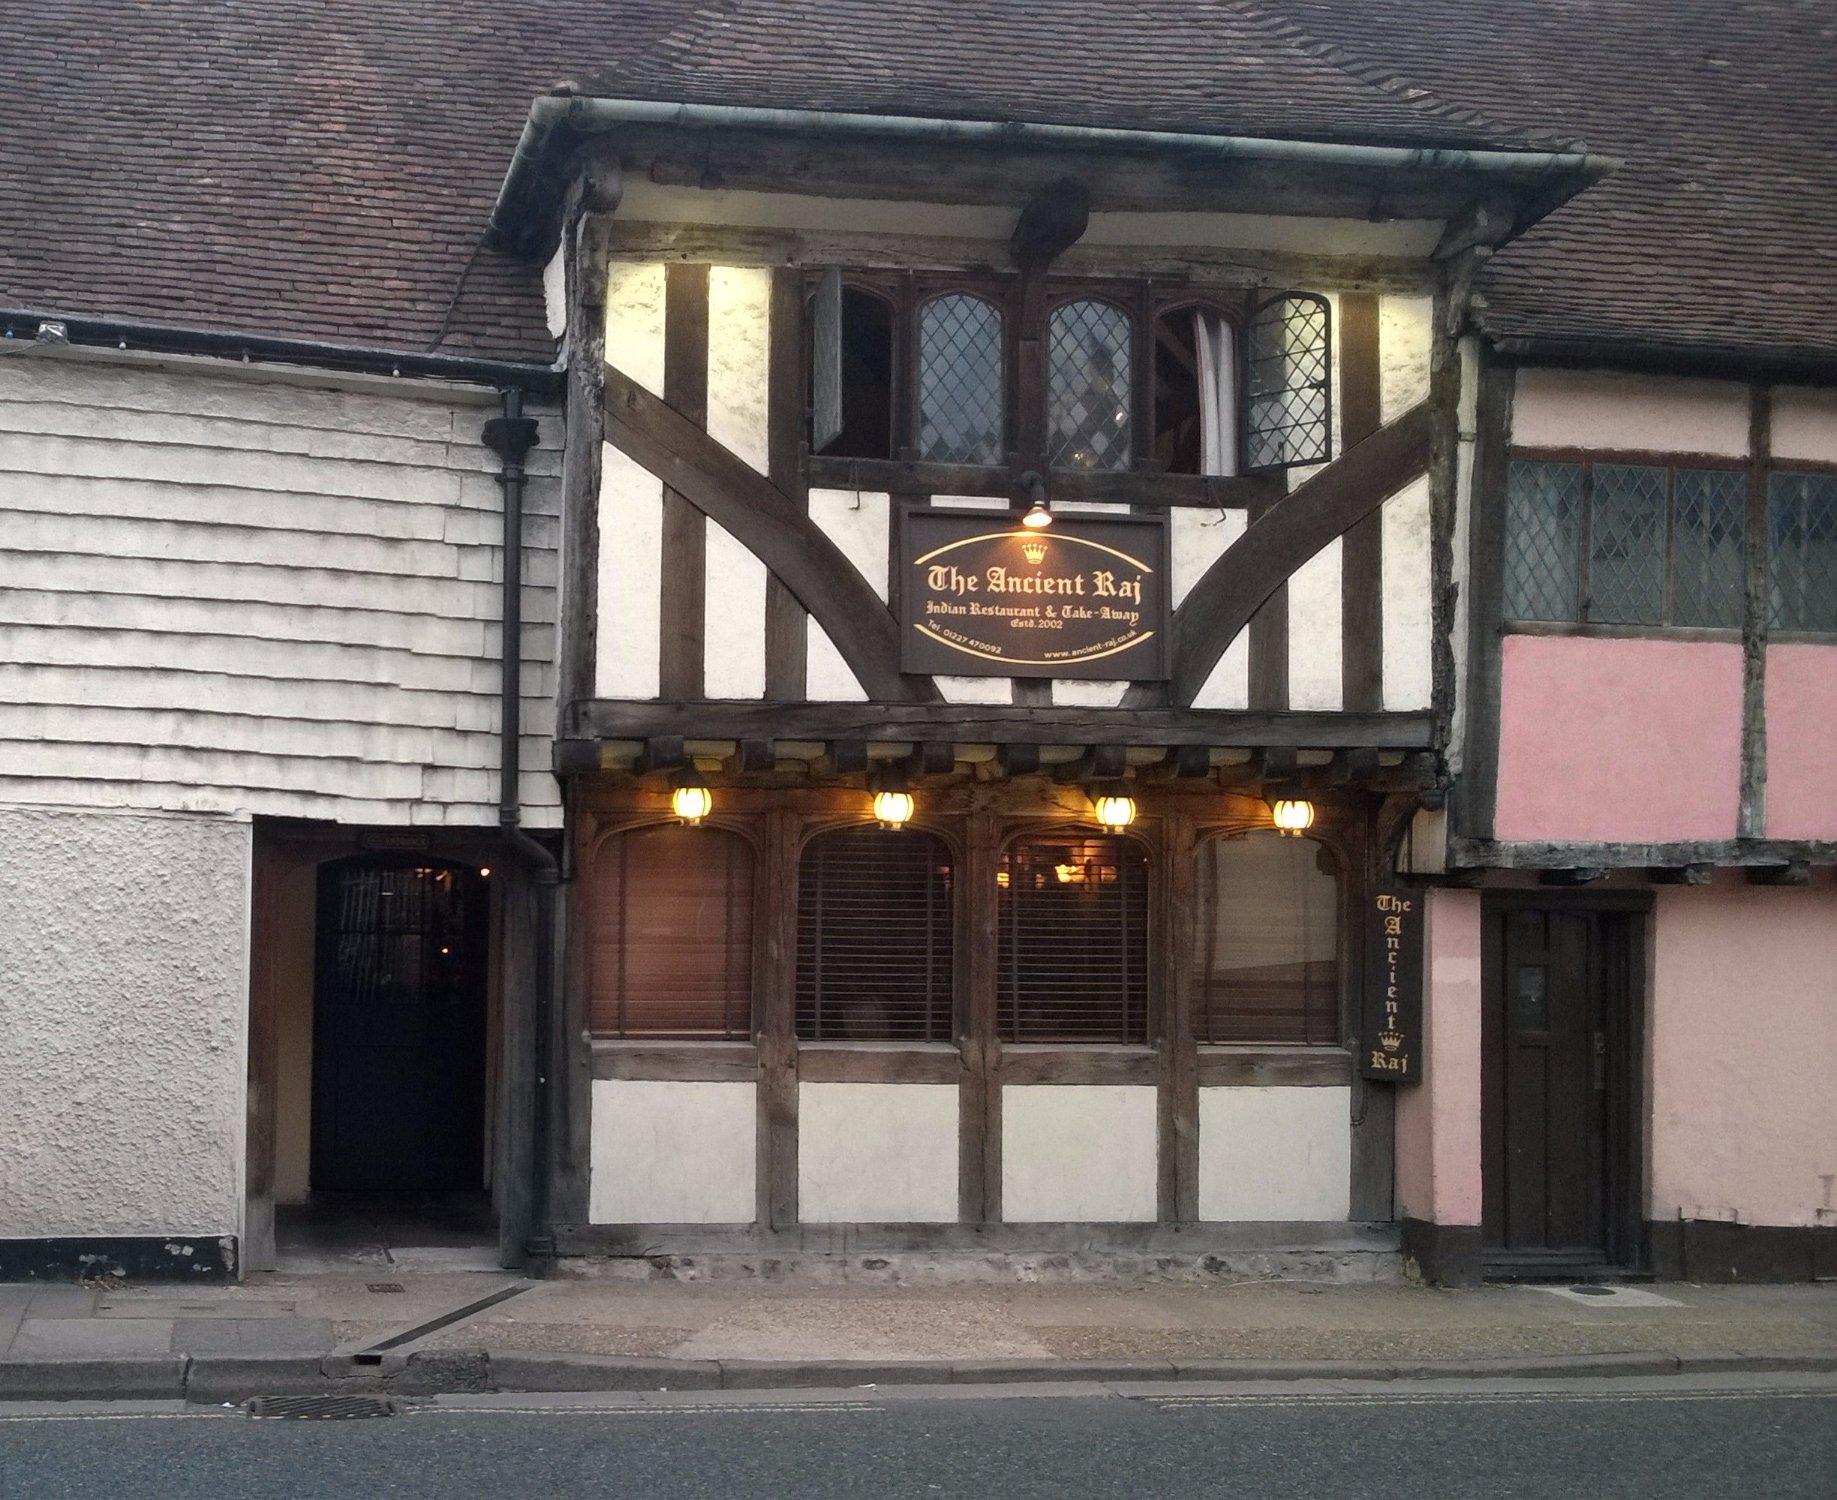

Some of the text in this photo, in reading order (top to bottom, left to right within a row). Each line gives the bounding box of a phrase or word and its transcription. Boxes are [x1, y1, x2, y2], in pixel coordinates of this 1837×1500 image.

[927, 565, 1142, 605] The Ancient Raj
[926, 601, 1140, 627] Indian Restaurant & Take-Away
[943, 629, 968, 642] 01227
[1370, 894, 1412, 1074] The Ancient Raj
